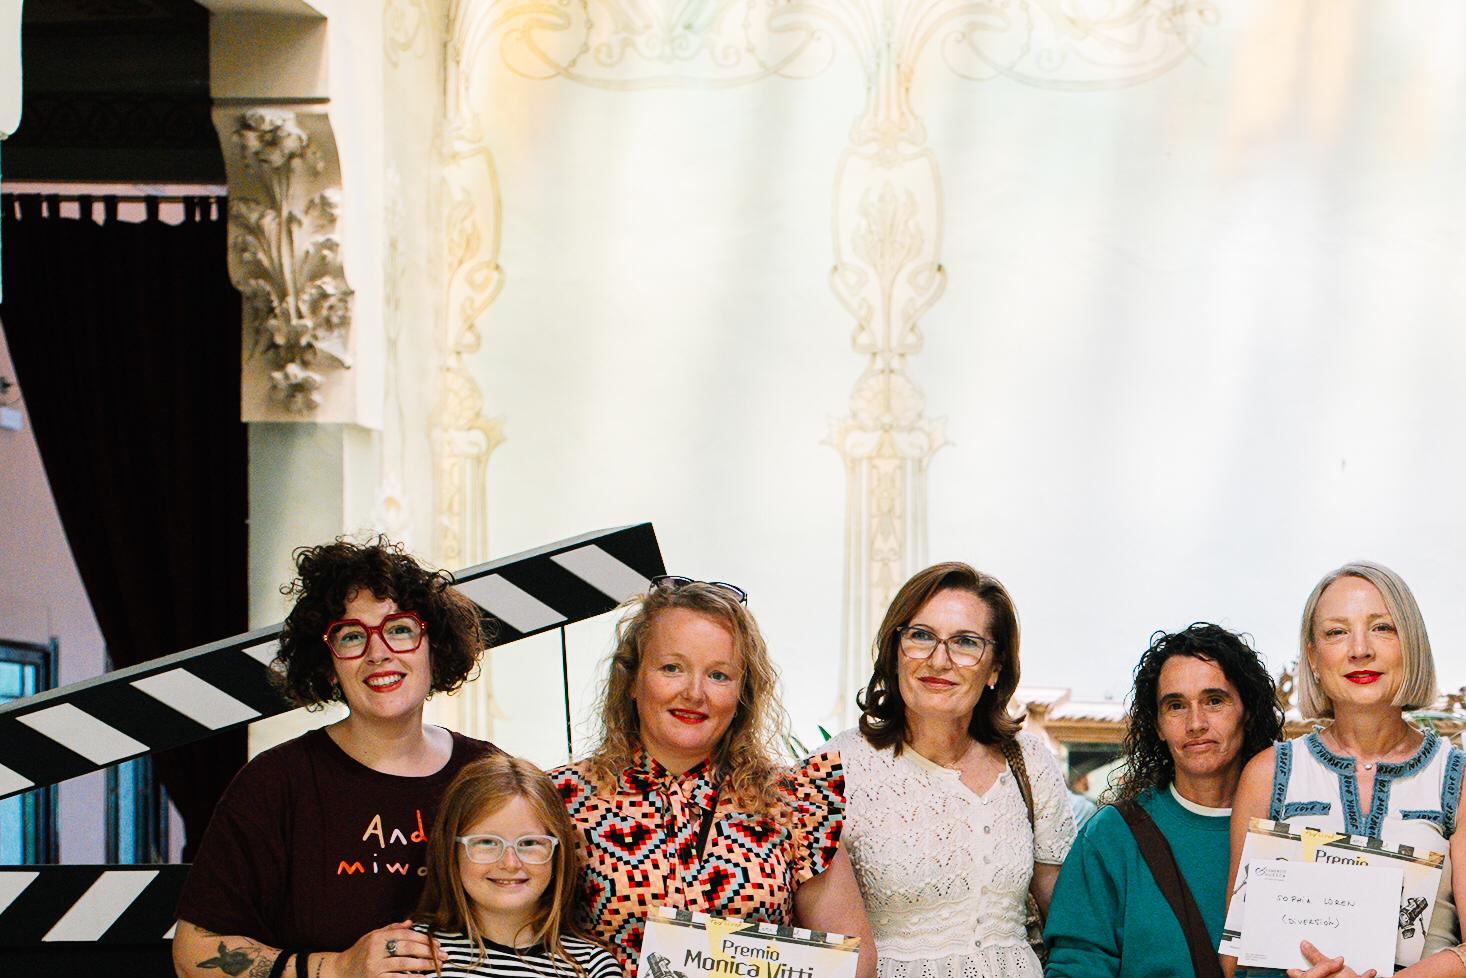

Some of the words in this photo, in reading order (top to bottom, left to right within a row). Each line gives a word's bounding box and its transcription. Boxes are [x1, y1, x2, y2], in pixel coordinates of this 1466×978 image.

[1324, 895, 1355, 906] LOREN
[722, 939, 780, 961] Premio
[684, 949, 760, 978] Monica
